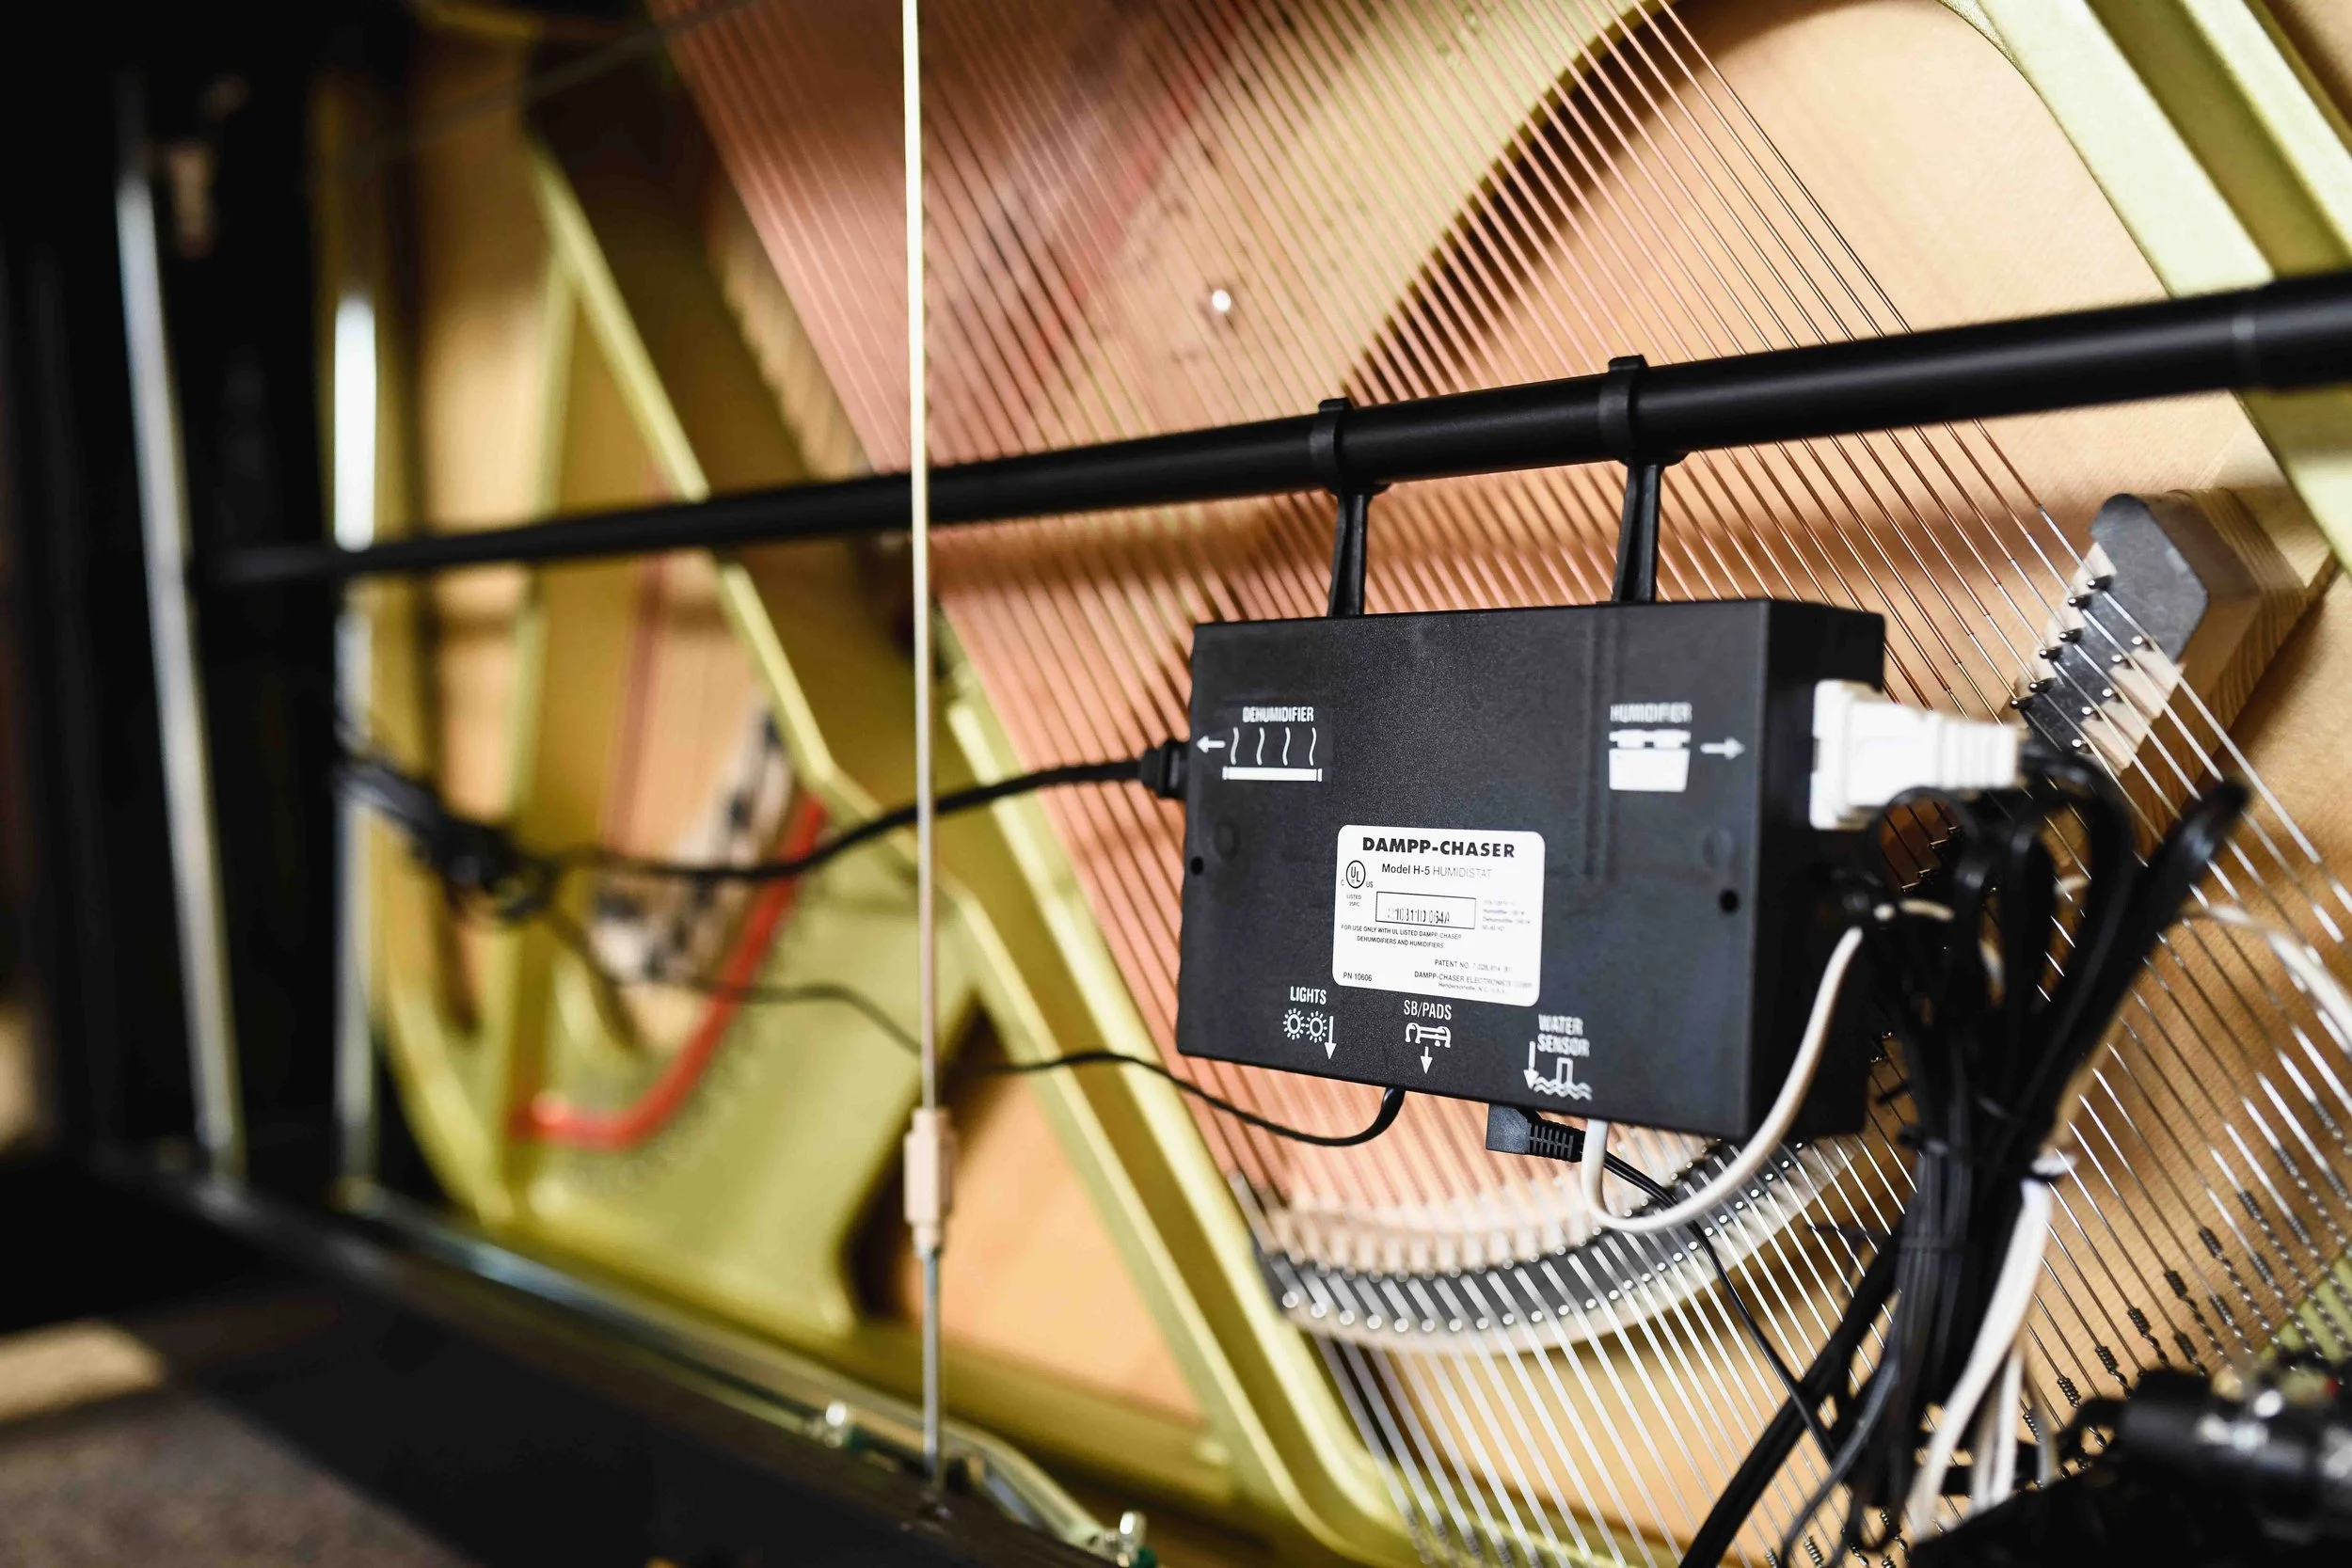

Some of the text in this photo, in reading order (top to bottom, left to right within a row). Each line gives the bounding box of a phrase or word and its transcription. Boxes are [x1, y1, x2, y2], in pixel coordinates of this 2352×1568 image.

[1243, 706, 1314, 722] DEHUMIDIFIER
[1610, 702, 1692, 723] HUMIDIFIER
[1362, 836, 1515, 858] DAMPP-CHASER
[1381, 863, 1493, 879] Model H-5 HUMIDISTAT
[1357, 935, 1397, 945] DEHUMIDIFIERS
[1409, 940, 1444, 949] HUMIDIFIERS
[1399, 928, 1419, 937] LISTED
[1419, 930, 1462, 940] DAMPP-CHASER
[1434, 958, 1458, 968] PATENT
[1354, 973, 1373, 982] 10606
[1414, 971, 1465, 983] DAMPP-CHASER
[1289, 986, 1327, 1006] LIGHTS
[1403, 999, 1453, 1021] SB/PADS
[1537, 1013, 1584, 1036] WATER
[1536, 1033, 1591, 1057] SENSOR
